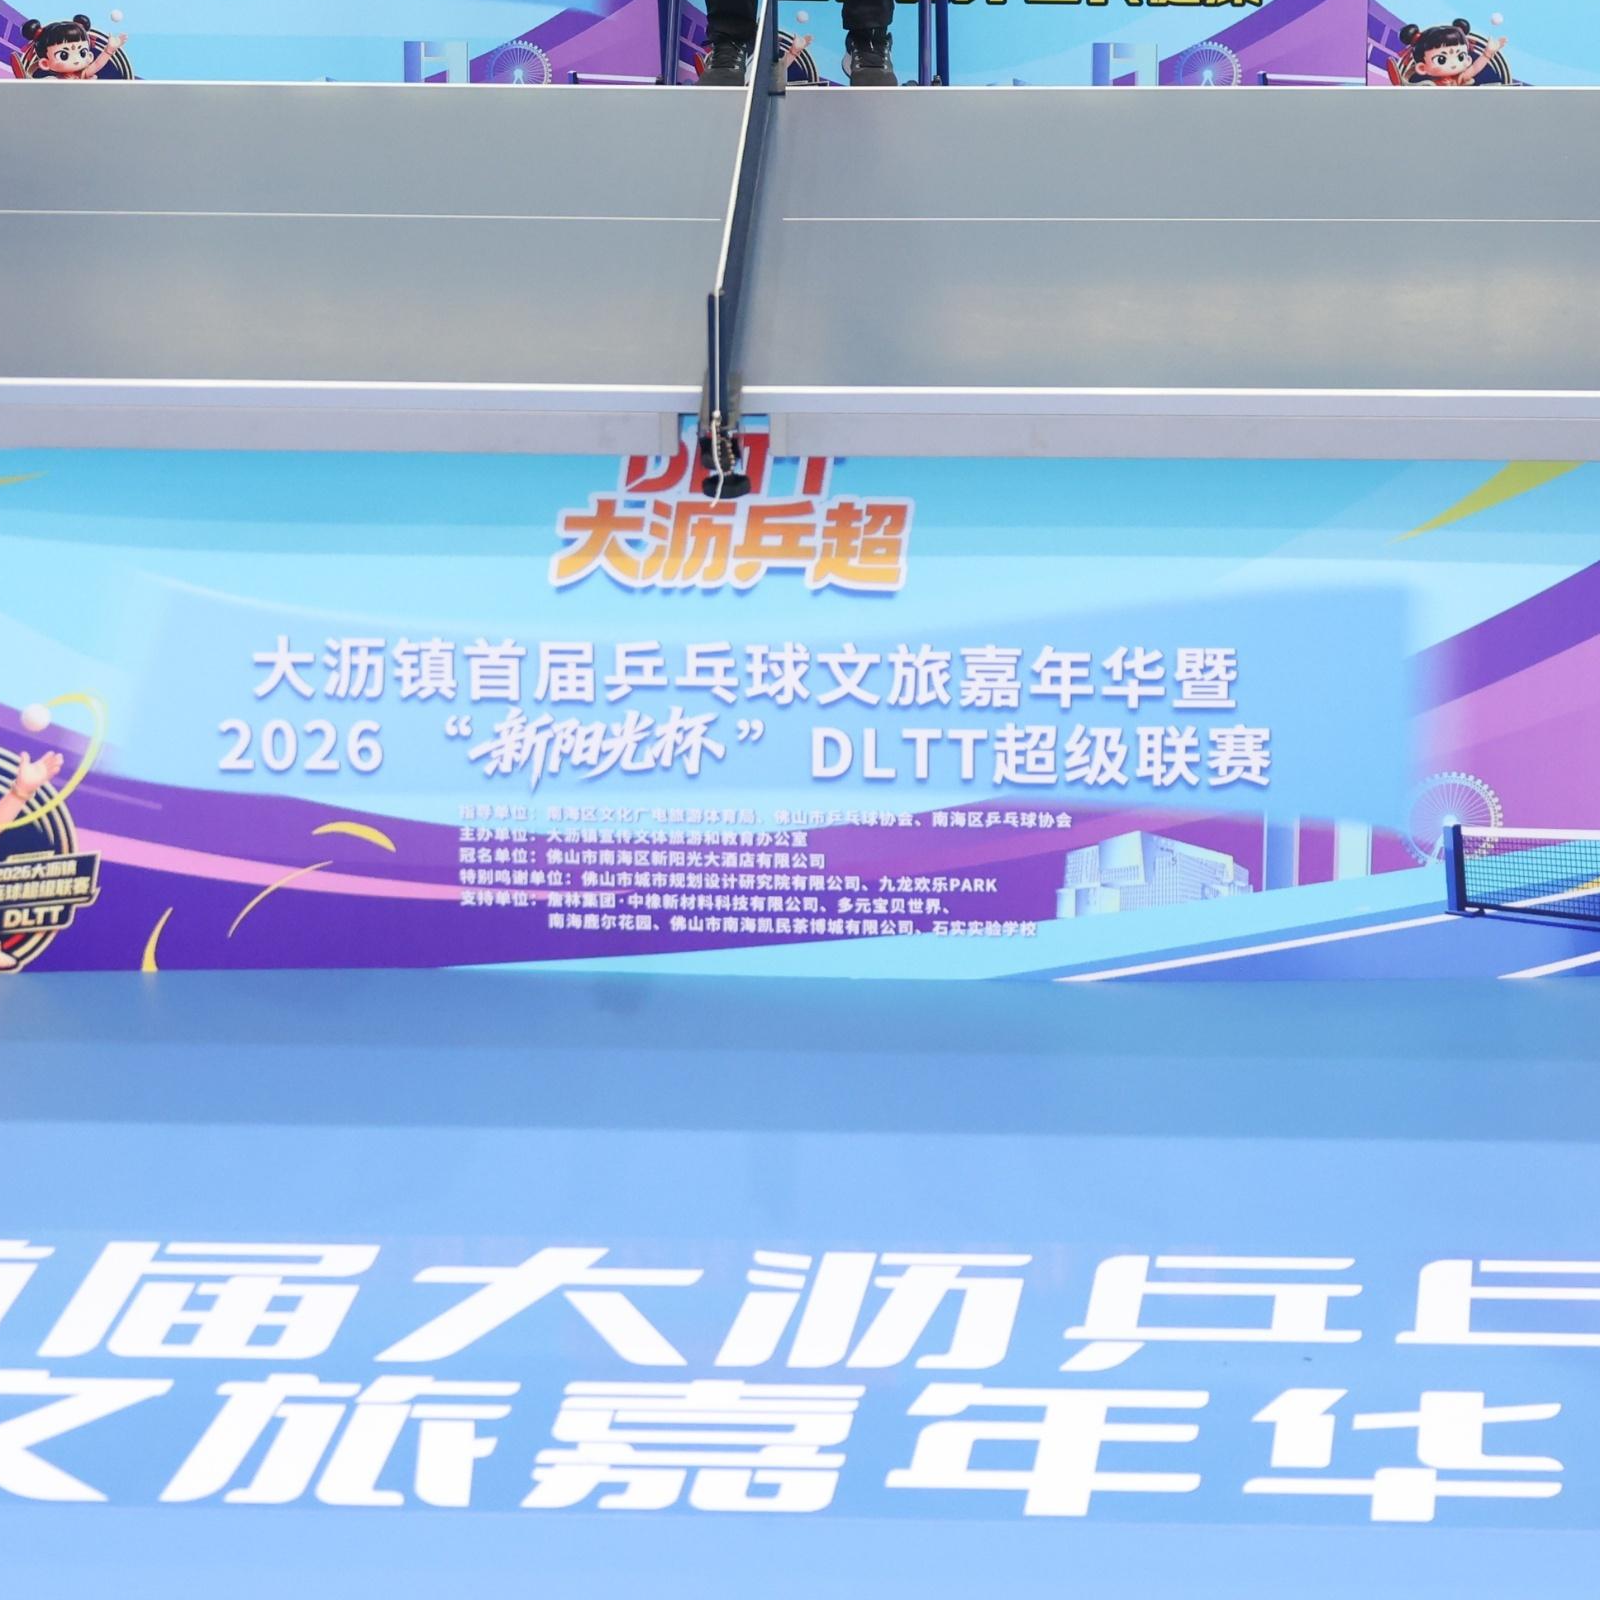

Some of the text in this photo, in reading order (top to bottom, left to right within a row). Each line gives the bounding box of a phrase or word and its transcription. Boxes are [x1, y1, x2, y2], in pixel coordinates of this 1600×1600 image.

[556, 499, 908, 585] 大沥乒超
[252, 635, 1239, 711] 大沥镇首届乒乓球文旅嘉年华暨
[218, 718, 384, 773] 2026
[810, 722, 1272, 788] DLTT超级联赛
[3, 905, 65, 928] DLTT
